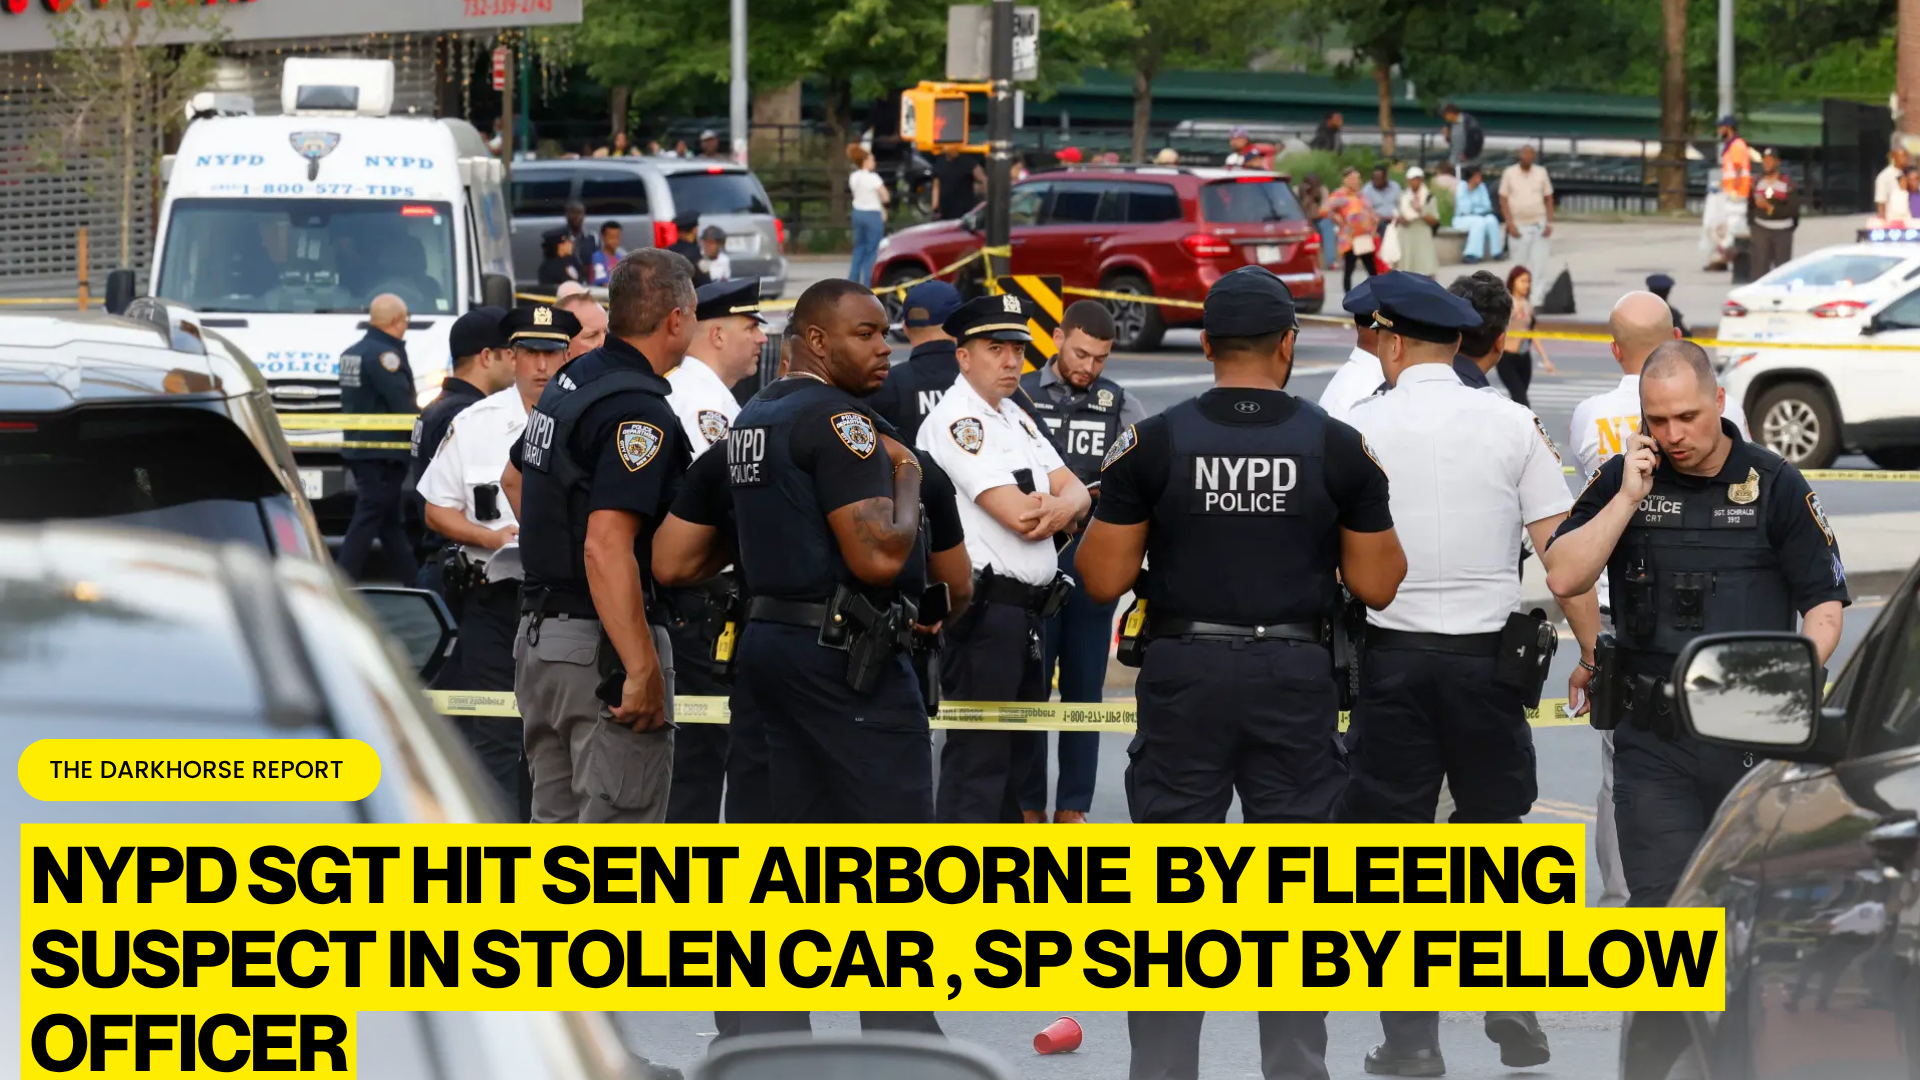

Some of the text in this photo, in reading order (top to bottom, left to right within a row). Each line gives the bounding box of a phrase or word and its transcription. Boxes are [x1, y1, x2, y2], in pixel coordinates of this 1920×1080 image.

[196, 155, 265, 167] NYPD
[365, 155, 434, 169] NYPD
[267, 352, 331, 360] NYPD
[841, 414, 862, 425] POLICE
[524, 408, 555, 450] NYPD
[631, 424, 653, 435] POLICE
[727, 428, 766, 465] NYPD
[523, 442, 543, 467] TARU
[730, 462, 761, 485] POLICE
[1195, 456, 1297, 492] NYPD
[1205, 492, 1286, 513] POLICE
[1639, 499, 1682, 514] OLICE
[1645, 514, 1662, 522] CRT
[1727, 516, 1741, 524] 3912
